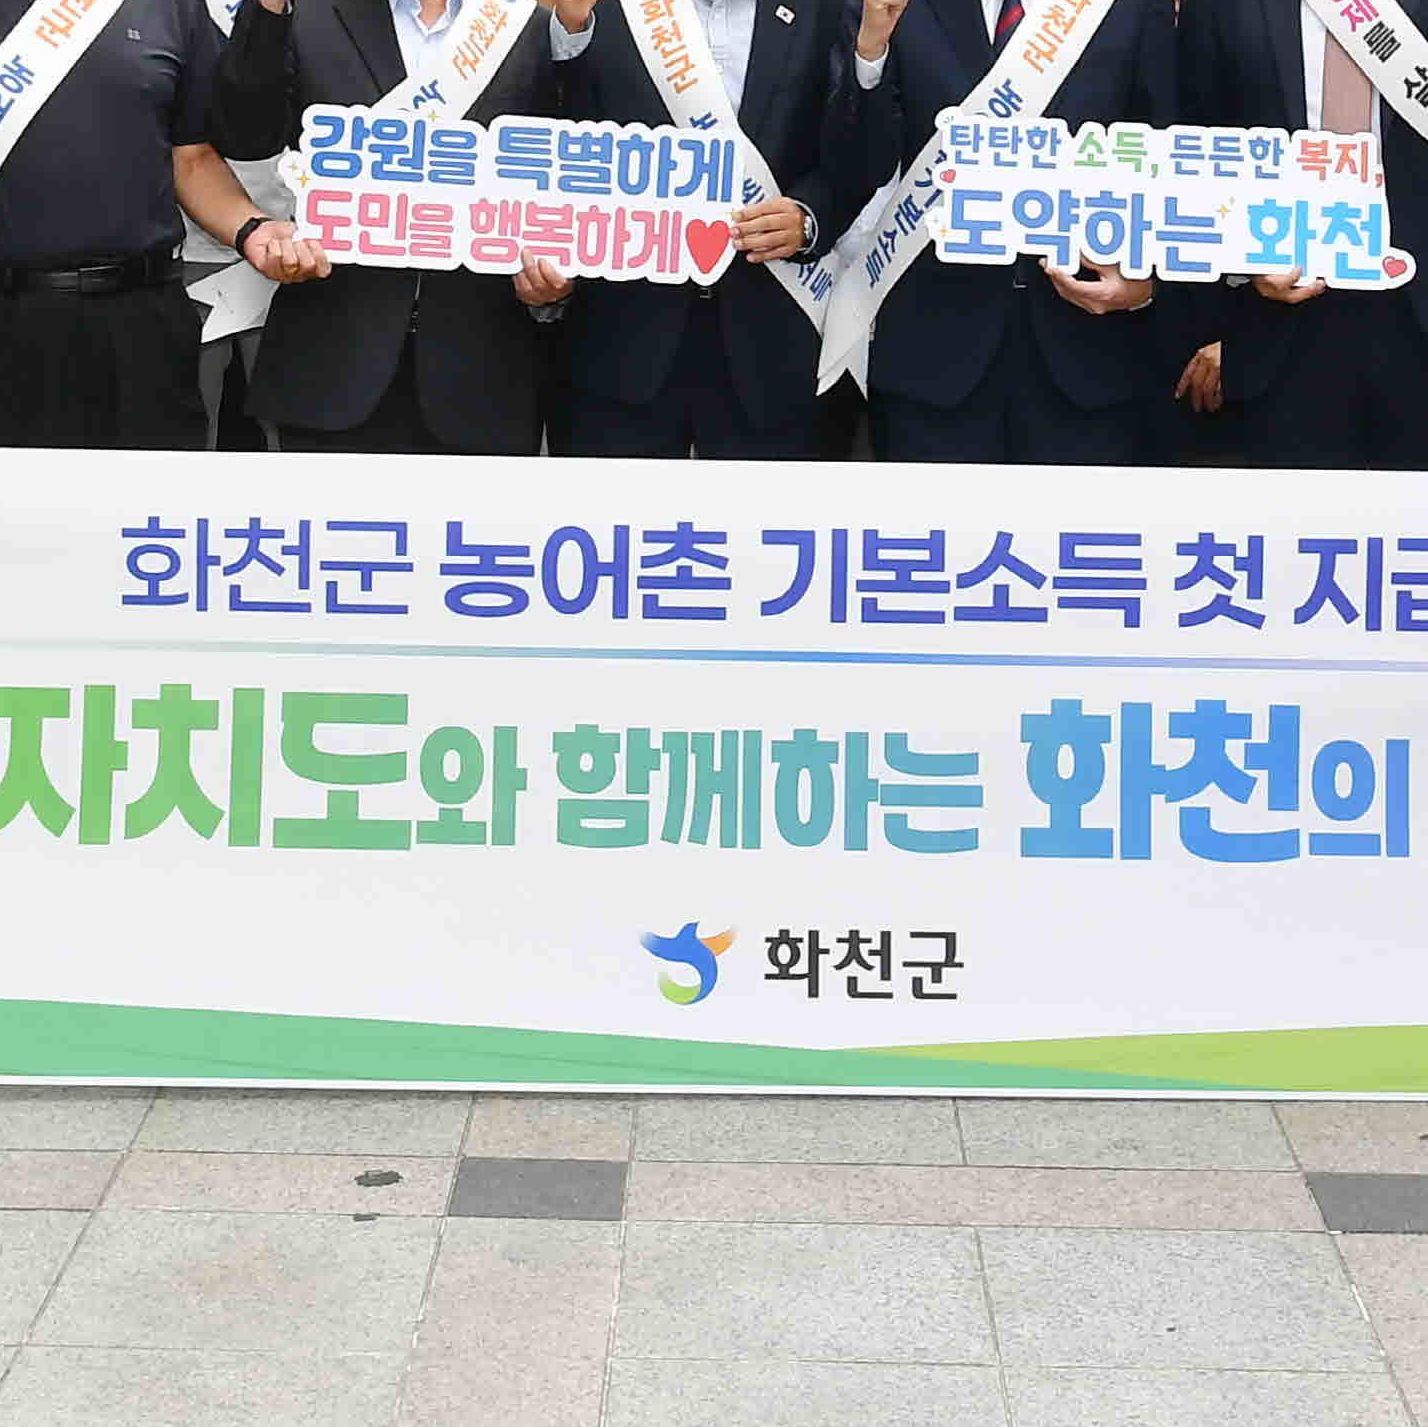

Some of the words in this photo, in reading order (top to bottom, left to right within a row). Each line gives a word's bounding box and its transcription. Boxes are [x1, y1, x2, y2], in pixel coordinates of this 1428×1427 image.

[450, 2, 509, 80] 화천군
[311, 114, 478, 186] 강원을
[495, 125, 735, 203] 특별하게
[950, 123, 1062, 169] 탄탄한
[1074, 132, 1159, 178] 소득,
[1170, 133, 1285, 179] 든든한
[1296, 139, 1384, 187] 복지,
[306, 189, 455, 259] 도민을
[469, 198, 680, 274] 행복하게
[944, 188, 1223, 273] 도약하는
[1245, 199, 1383, 281] 화천
[123, 517, 413, 614] 화천군
[440, 521, 731, 620] 농어촌
[761, 529, 1147, 628] 기본소득
[1175, 533, 1265, 628] 첫
[554, 726, 983, 853] 함께하는
[1021, 699, 1409, 863] 화천의
[765, 930, 964, 999] 화천군
